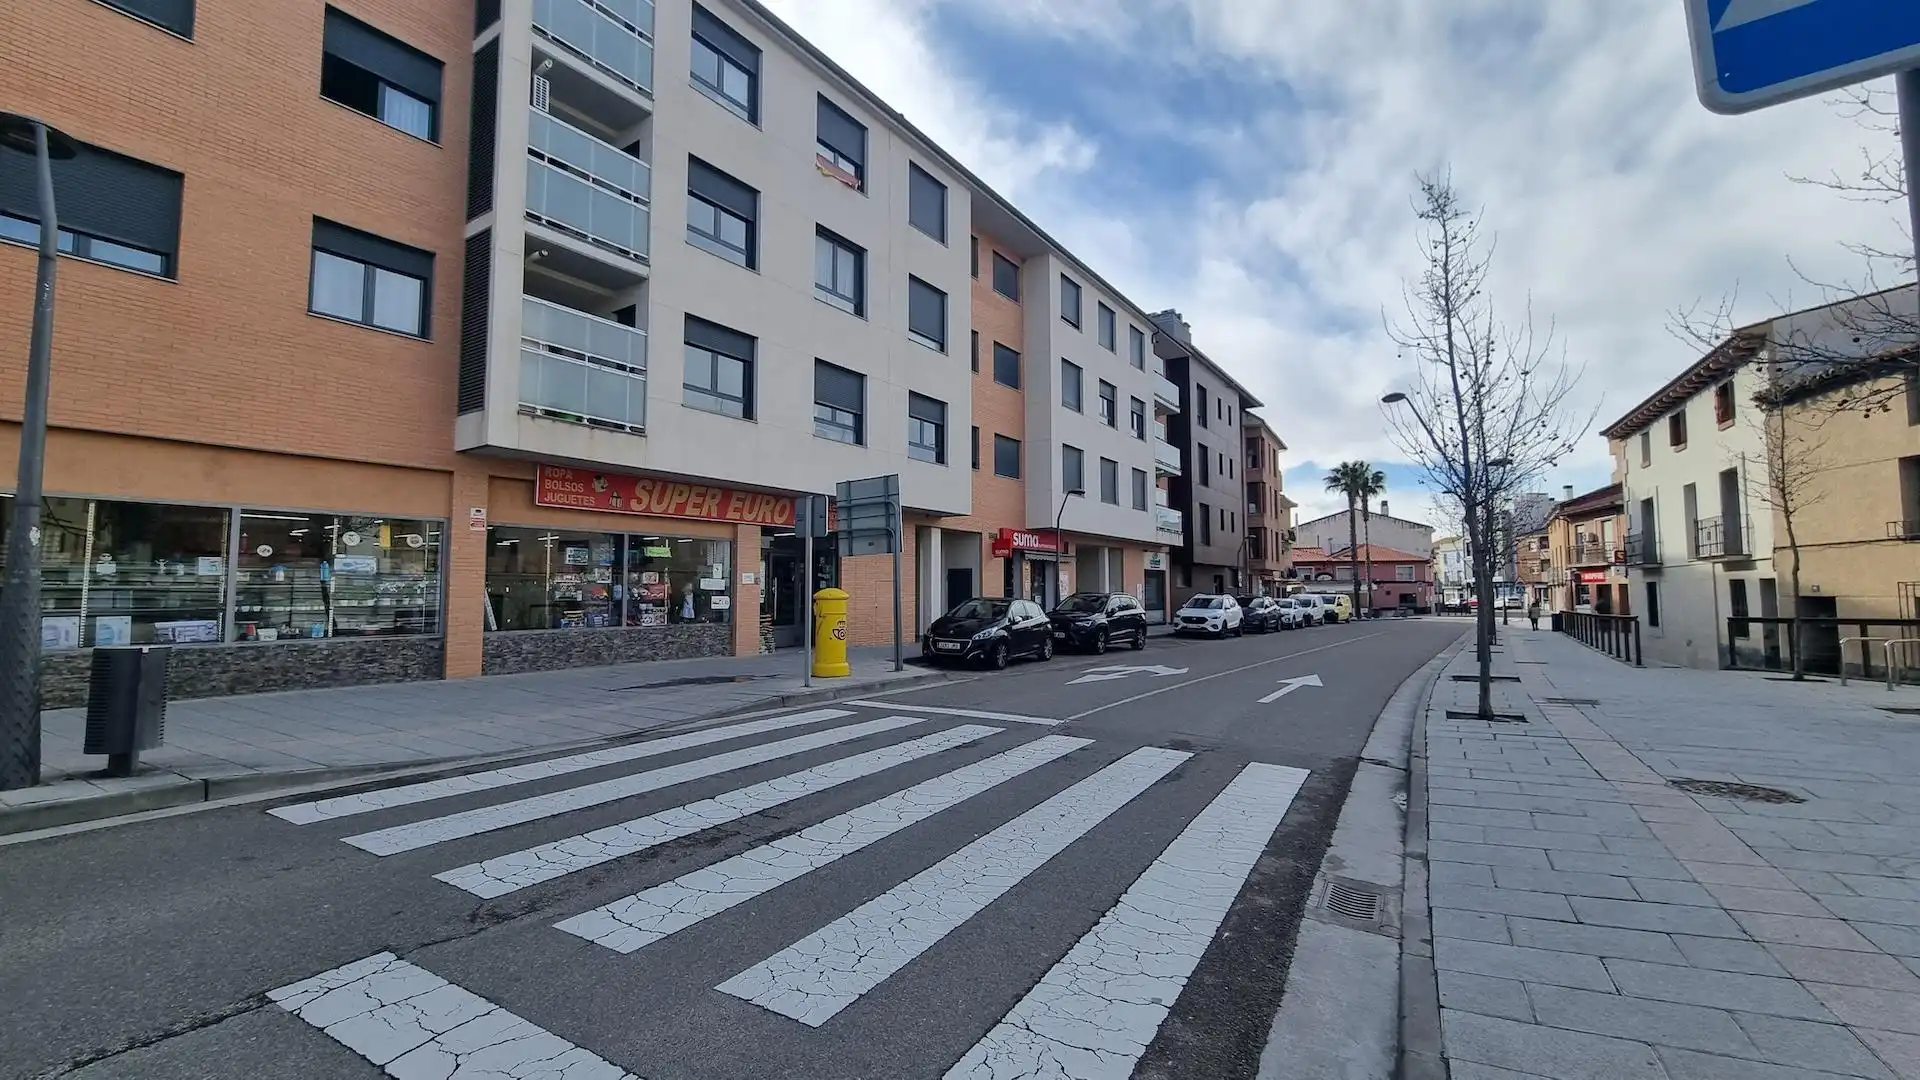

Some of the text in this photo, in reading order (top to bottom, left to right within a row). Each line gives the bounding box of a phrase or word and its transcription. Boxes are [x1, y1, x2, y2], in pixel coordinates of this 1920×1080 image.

[544, 467, 573, 480] ROPA
[544, 480, 584, 493] BOLSOS
[544, 491, 596, 506] JUGUETES
[630, 479, 722, 519] SUPER
[726, 489, 791, 524] EURO
[1012, 532, 1039, 548] suma
